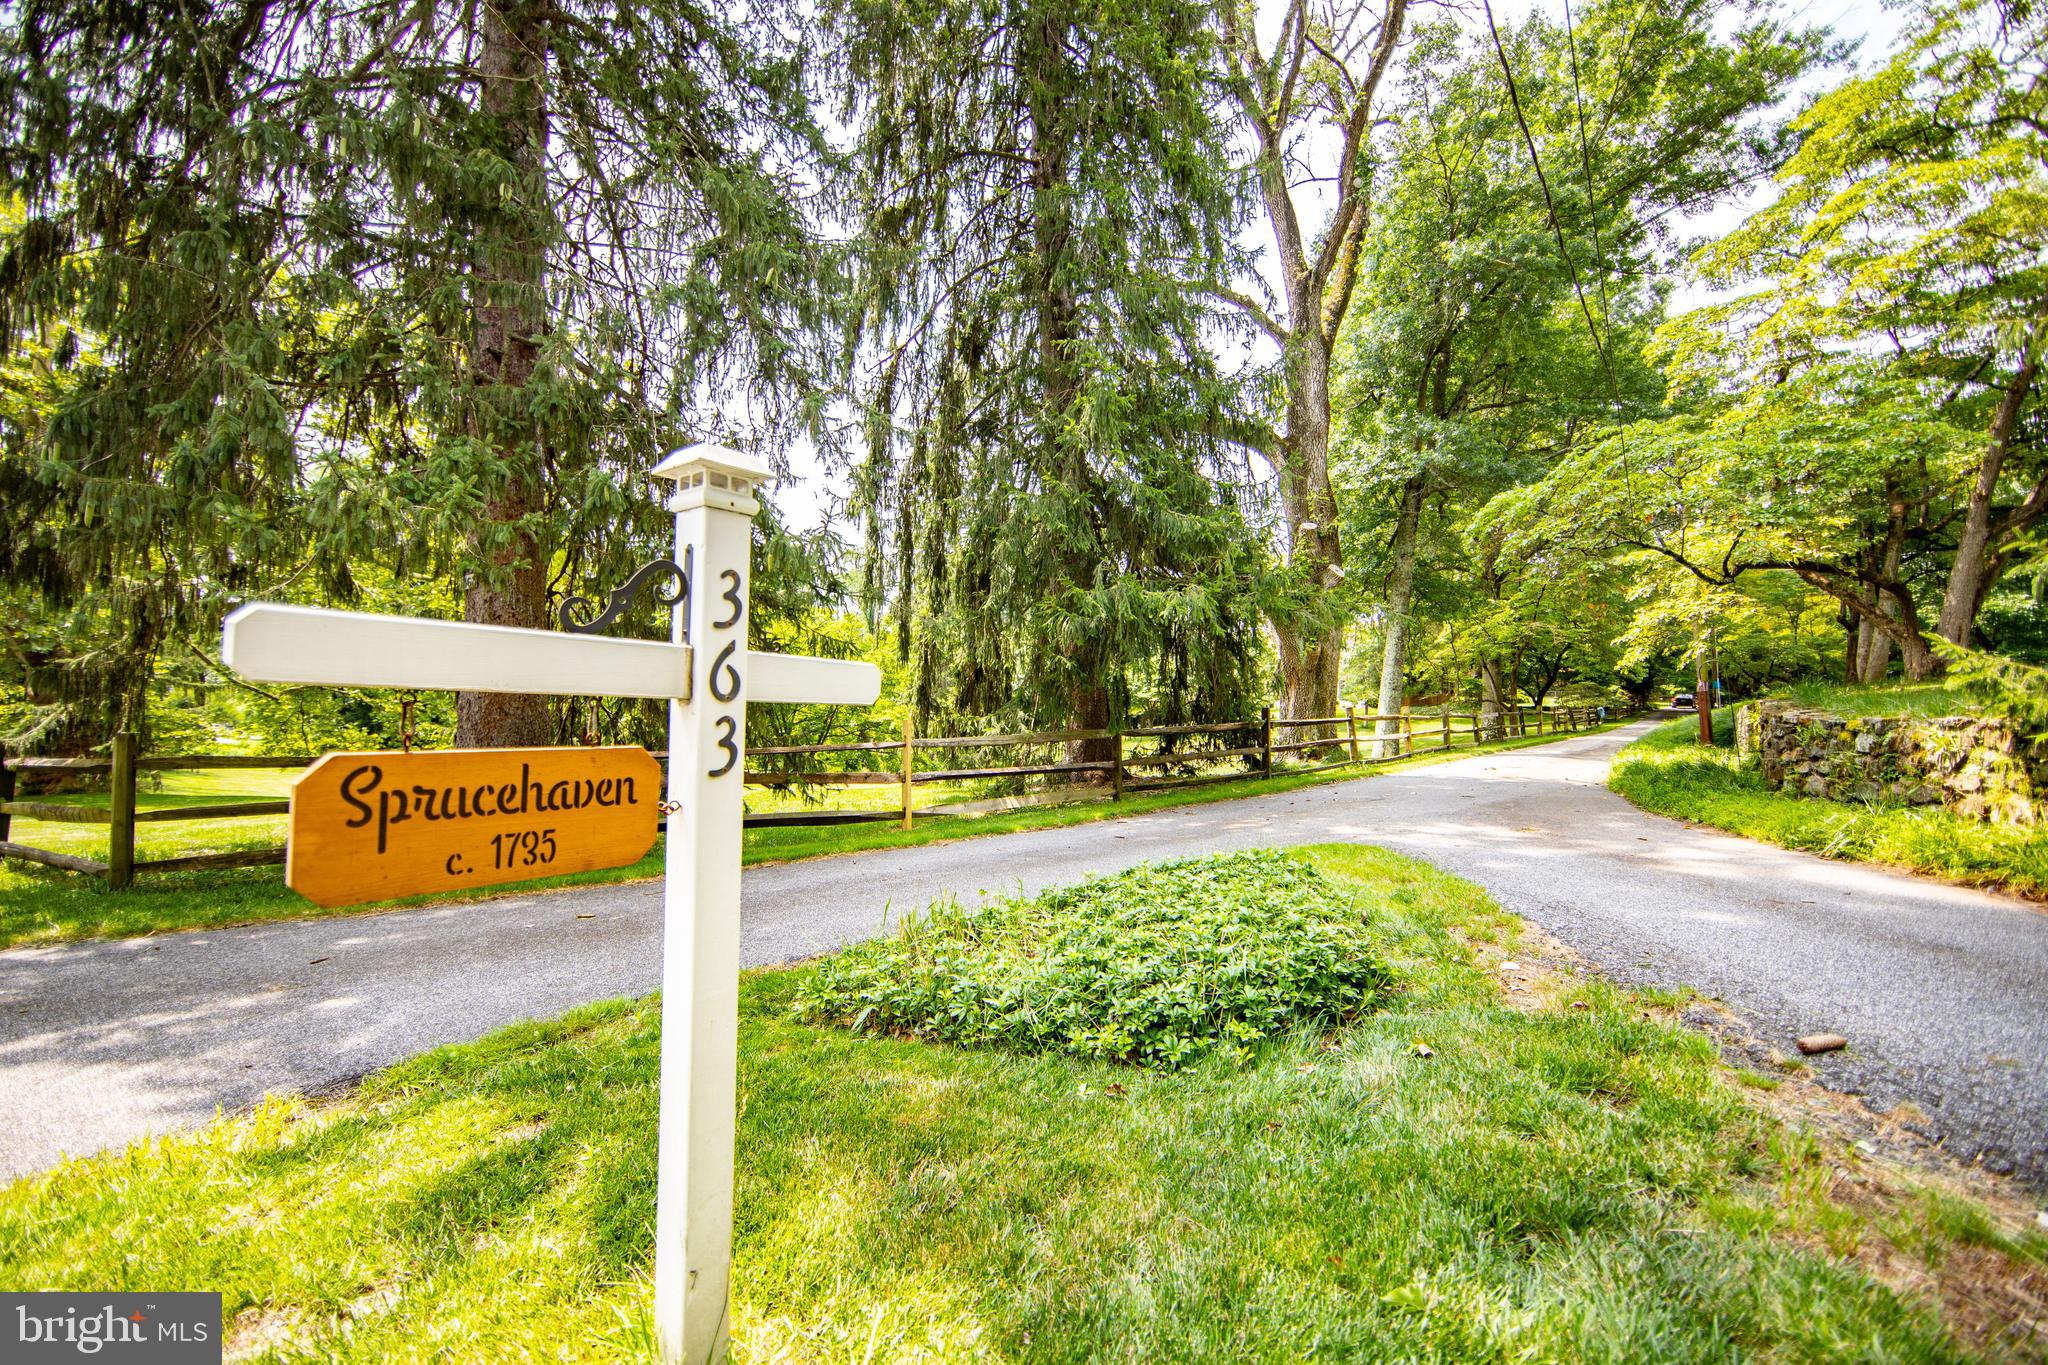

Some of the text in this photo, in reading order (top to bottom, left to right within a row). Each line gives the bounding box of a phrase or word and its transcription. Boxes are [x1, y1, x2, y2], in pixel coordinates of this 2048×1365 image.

[708, 569, 743, 777] 363
[340, 763, 638, 854] Sprucehaven
[446, 828, 557, 876] c. 1735
